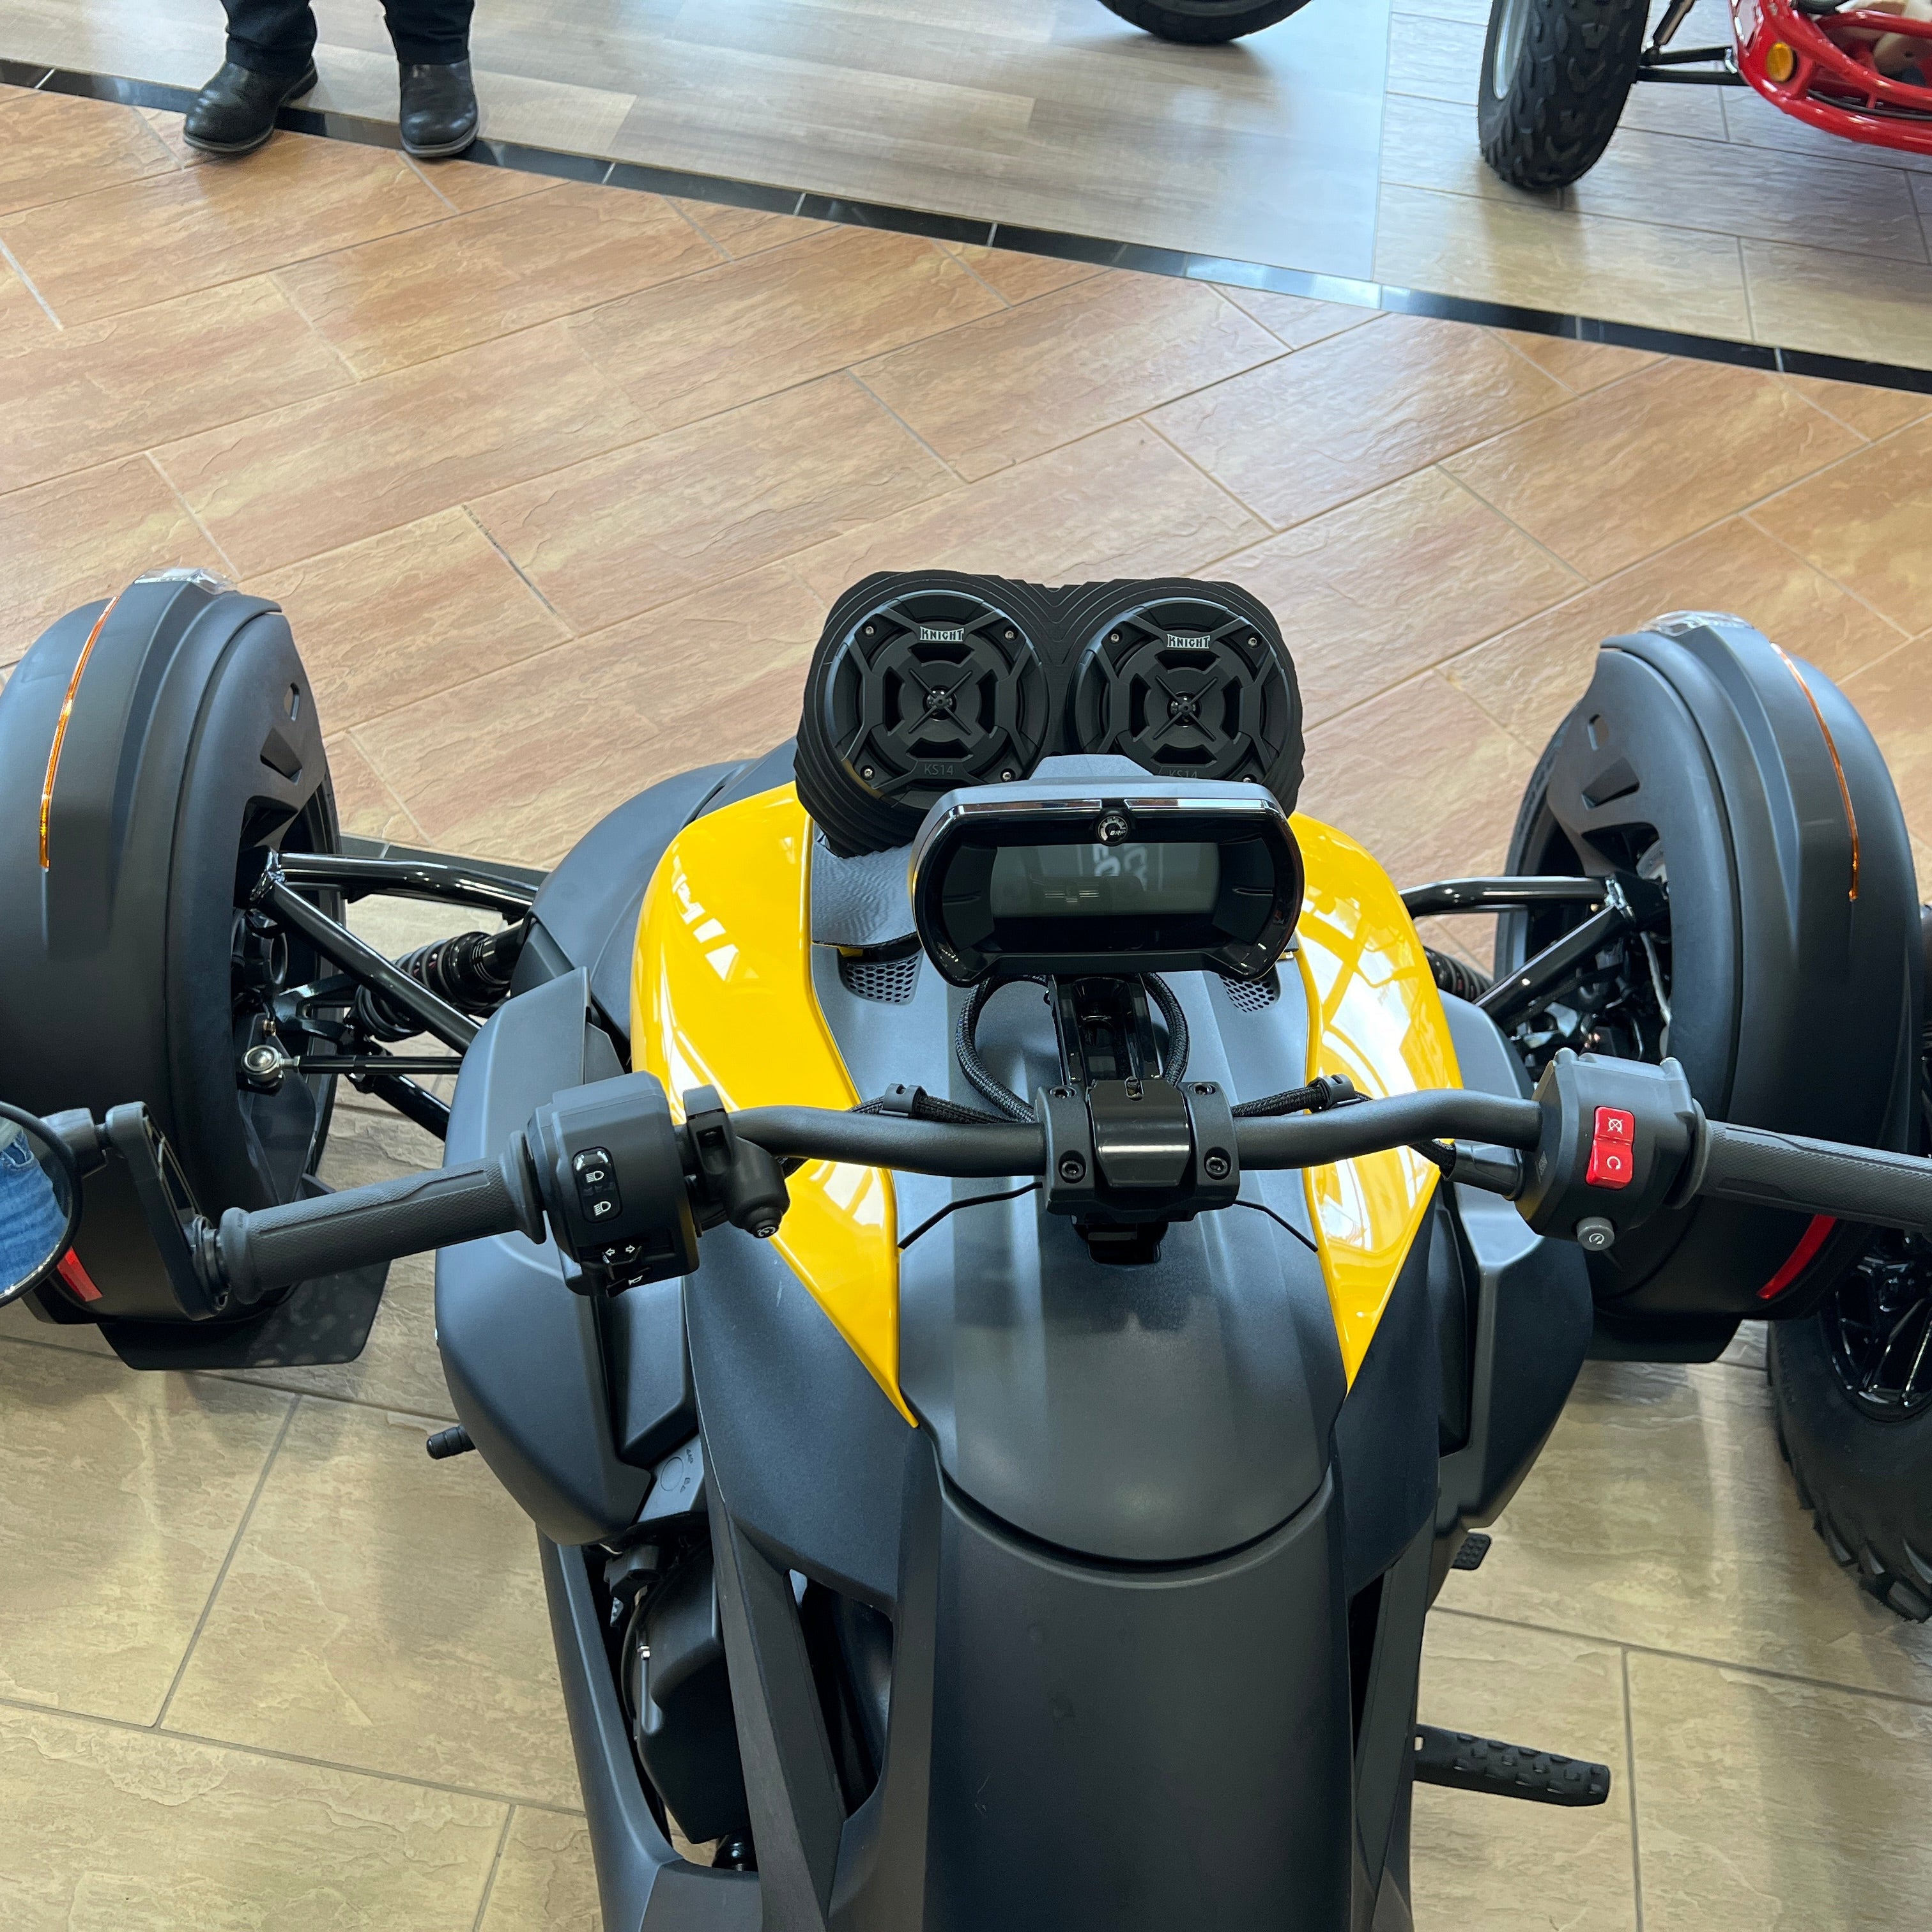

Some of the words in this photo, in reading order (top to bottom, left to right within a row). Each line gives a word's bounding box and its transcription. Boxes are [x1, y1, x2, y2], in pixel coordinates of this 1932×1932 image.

[920, 627, 963, 641] KNIGHT
[1167, 634, 1209, 648] KNIGHT
[924, 763, 954, 775] KS14
